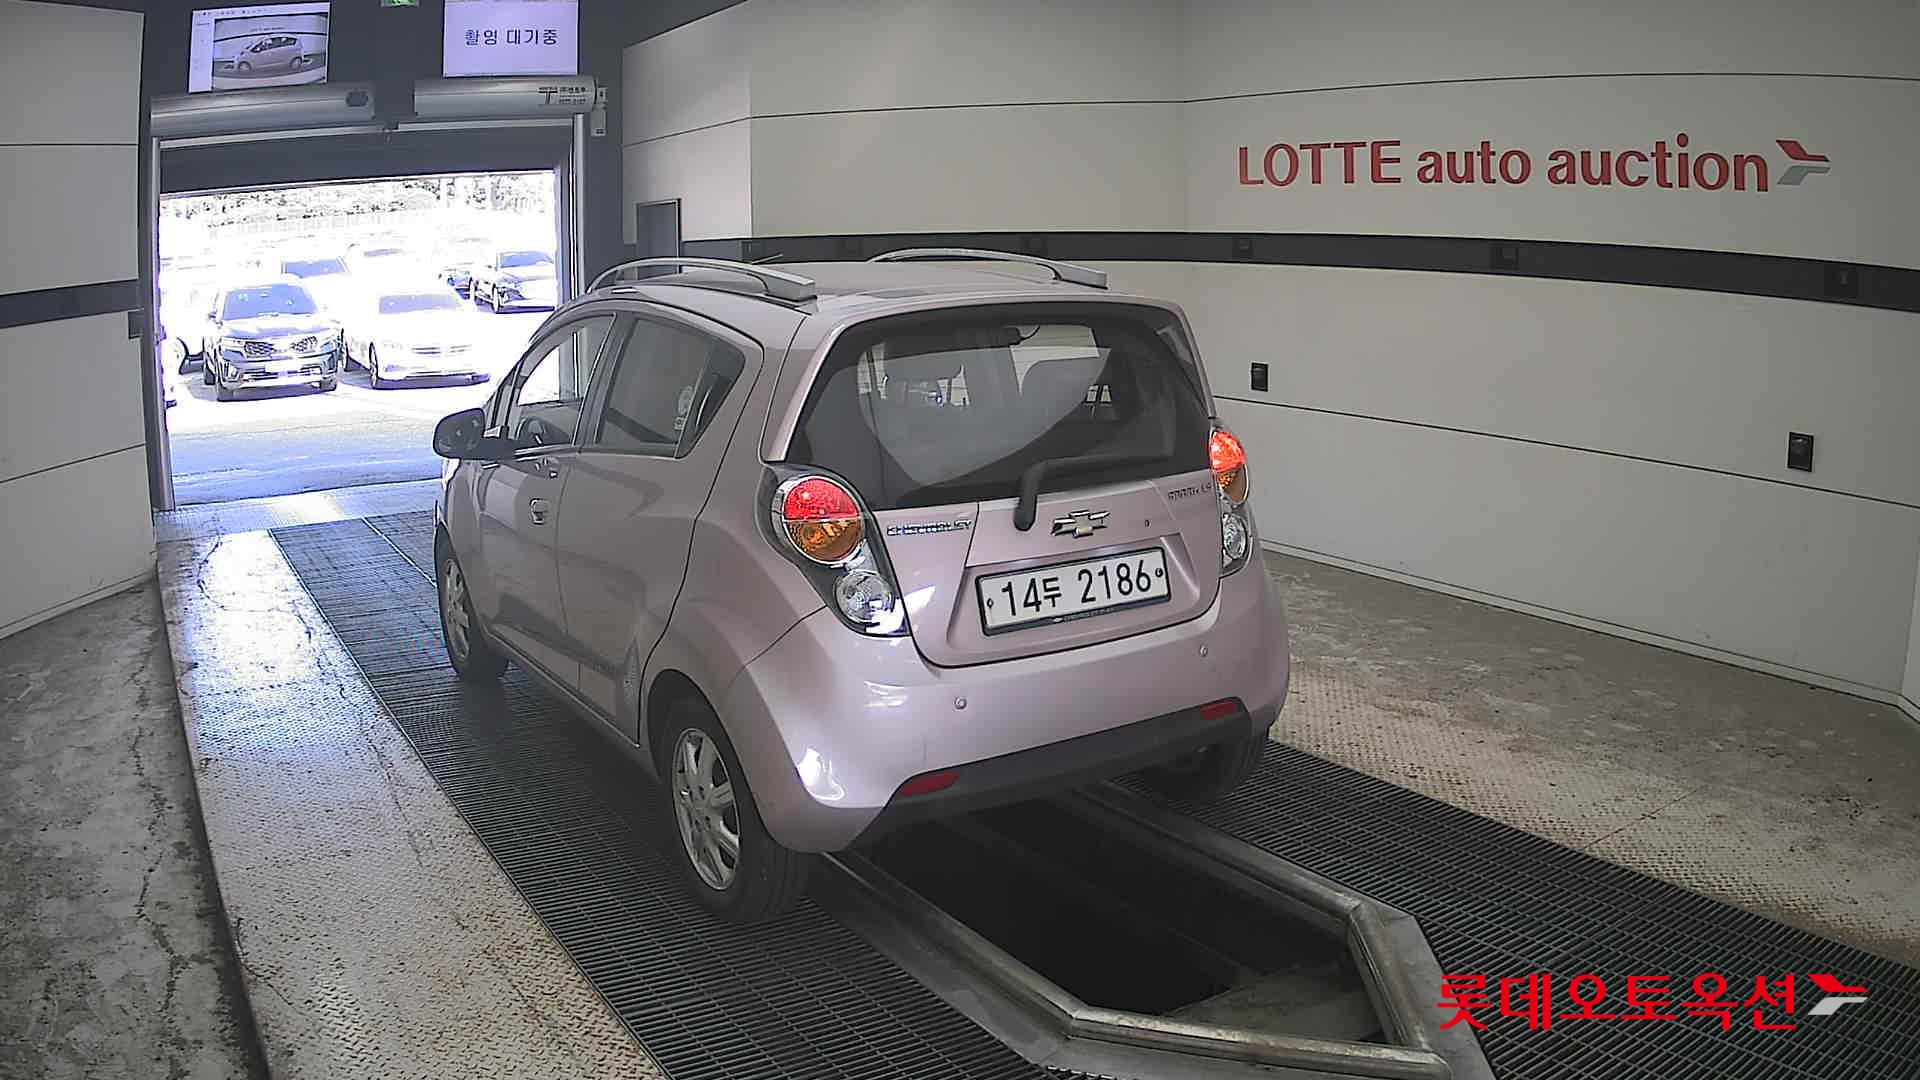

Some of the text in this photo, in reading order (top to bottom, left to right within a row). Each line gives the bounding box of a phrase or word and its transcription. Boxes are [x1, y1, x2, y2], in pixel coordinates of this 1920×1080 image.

[506, 28, 558, 46] 대기중
[1239, 133, 1769, 192] LOTTE auto auction
[1001, 559, 1151, 617] 14두 2186
